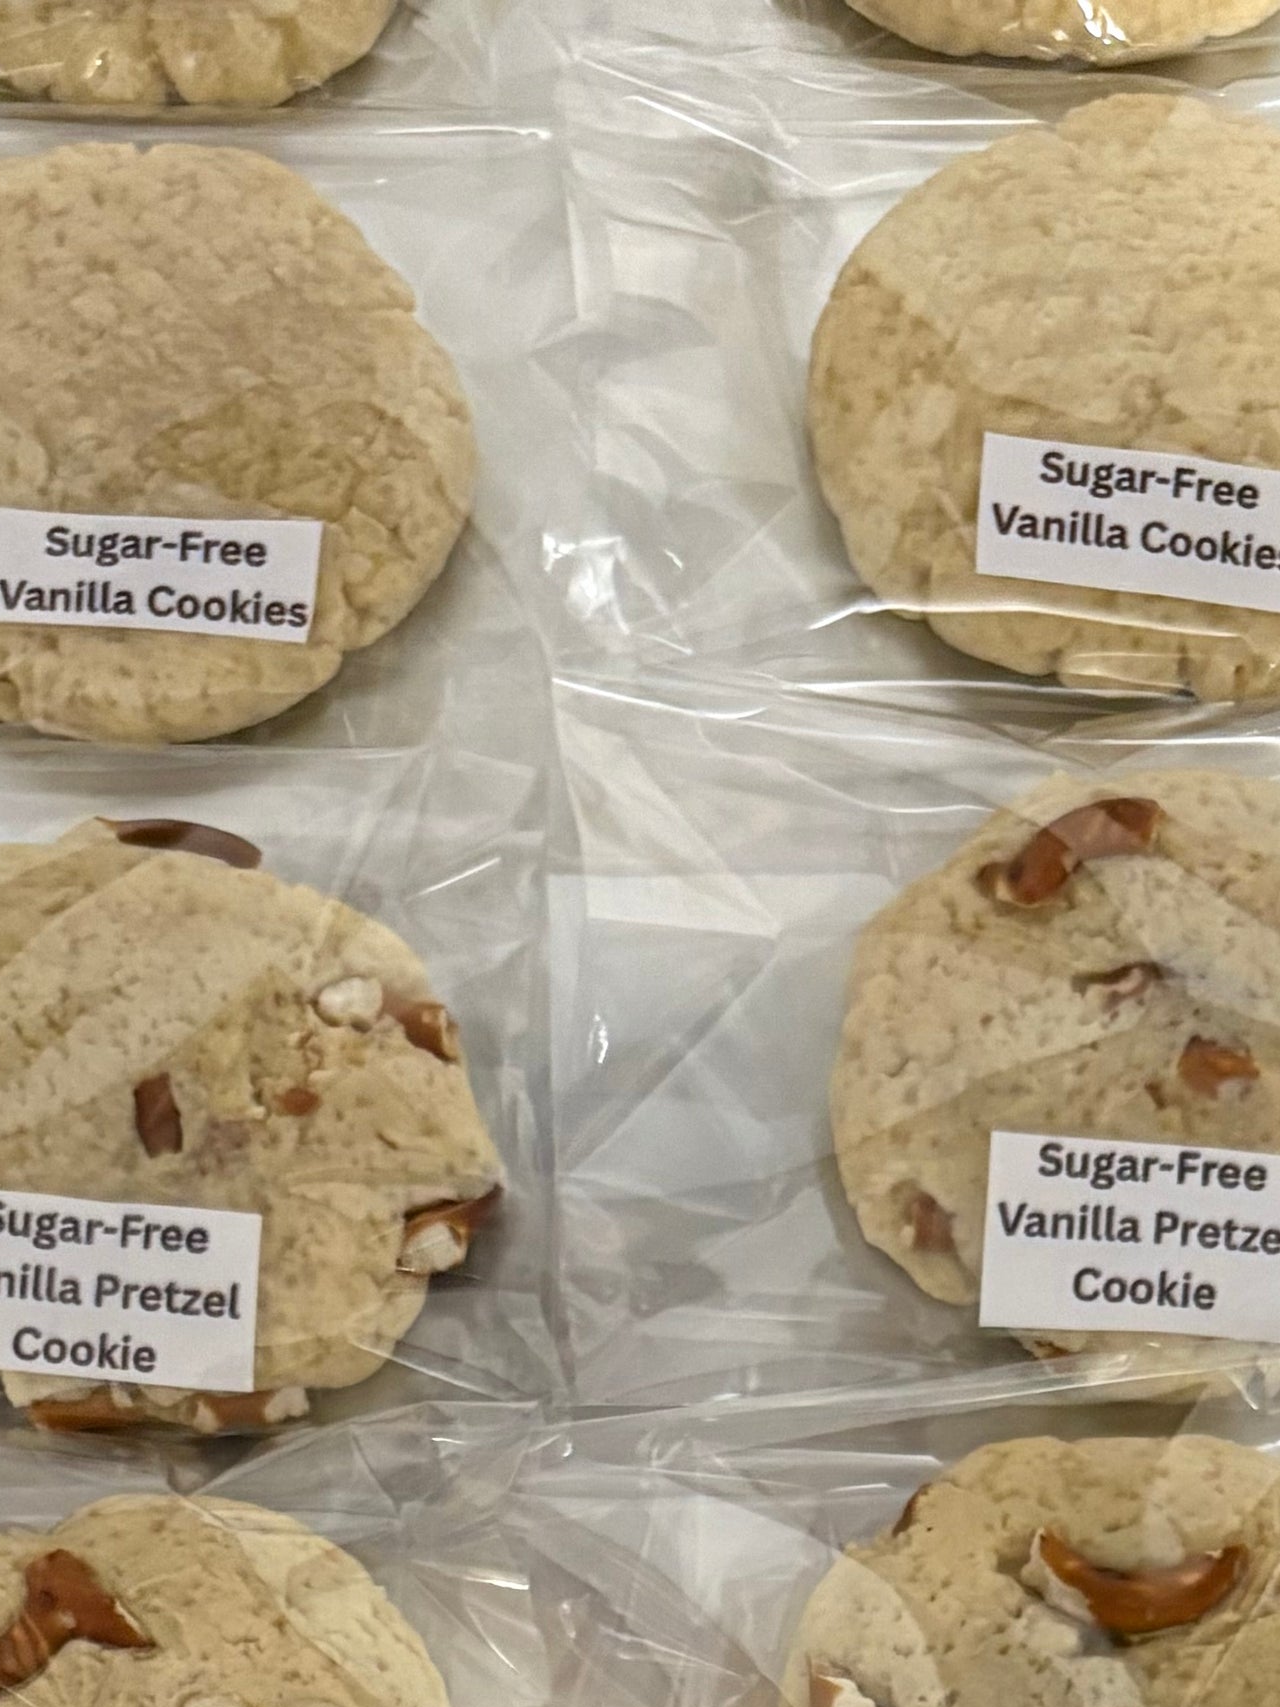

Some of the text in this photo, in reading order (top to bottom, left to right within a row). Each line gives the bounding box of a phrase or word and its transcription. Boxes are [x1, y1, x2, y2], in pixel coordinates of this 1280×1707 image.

[1039, 450, 1260, 510] Sugar-Free
[45, 525, 268, 568] Sugar-Free
[991, 502, 1130, 550] Vanilla
[146, 584, 308, 628] Cookies
[1038, 1141, 1268, 1192] Sugar-Free
[997, 1201, 1142, 1244] Vanilla
[93, 1272, 241, 1320] Pretzel
[1072, 1266, 1218, 1311] Cookie
[11, 1326, 157, 1374] Cookie
